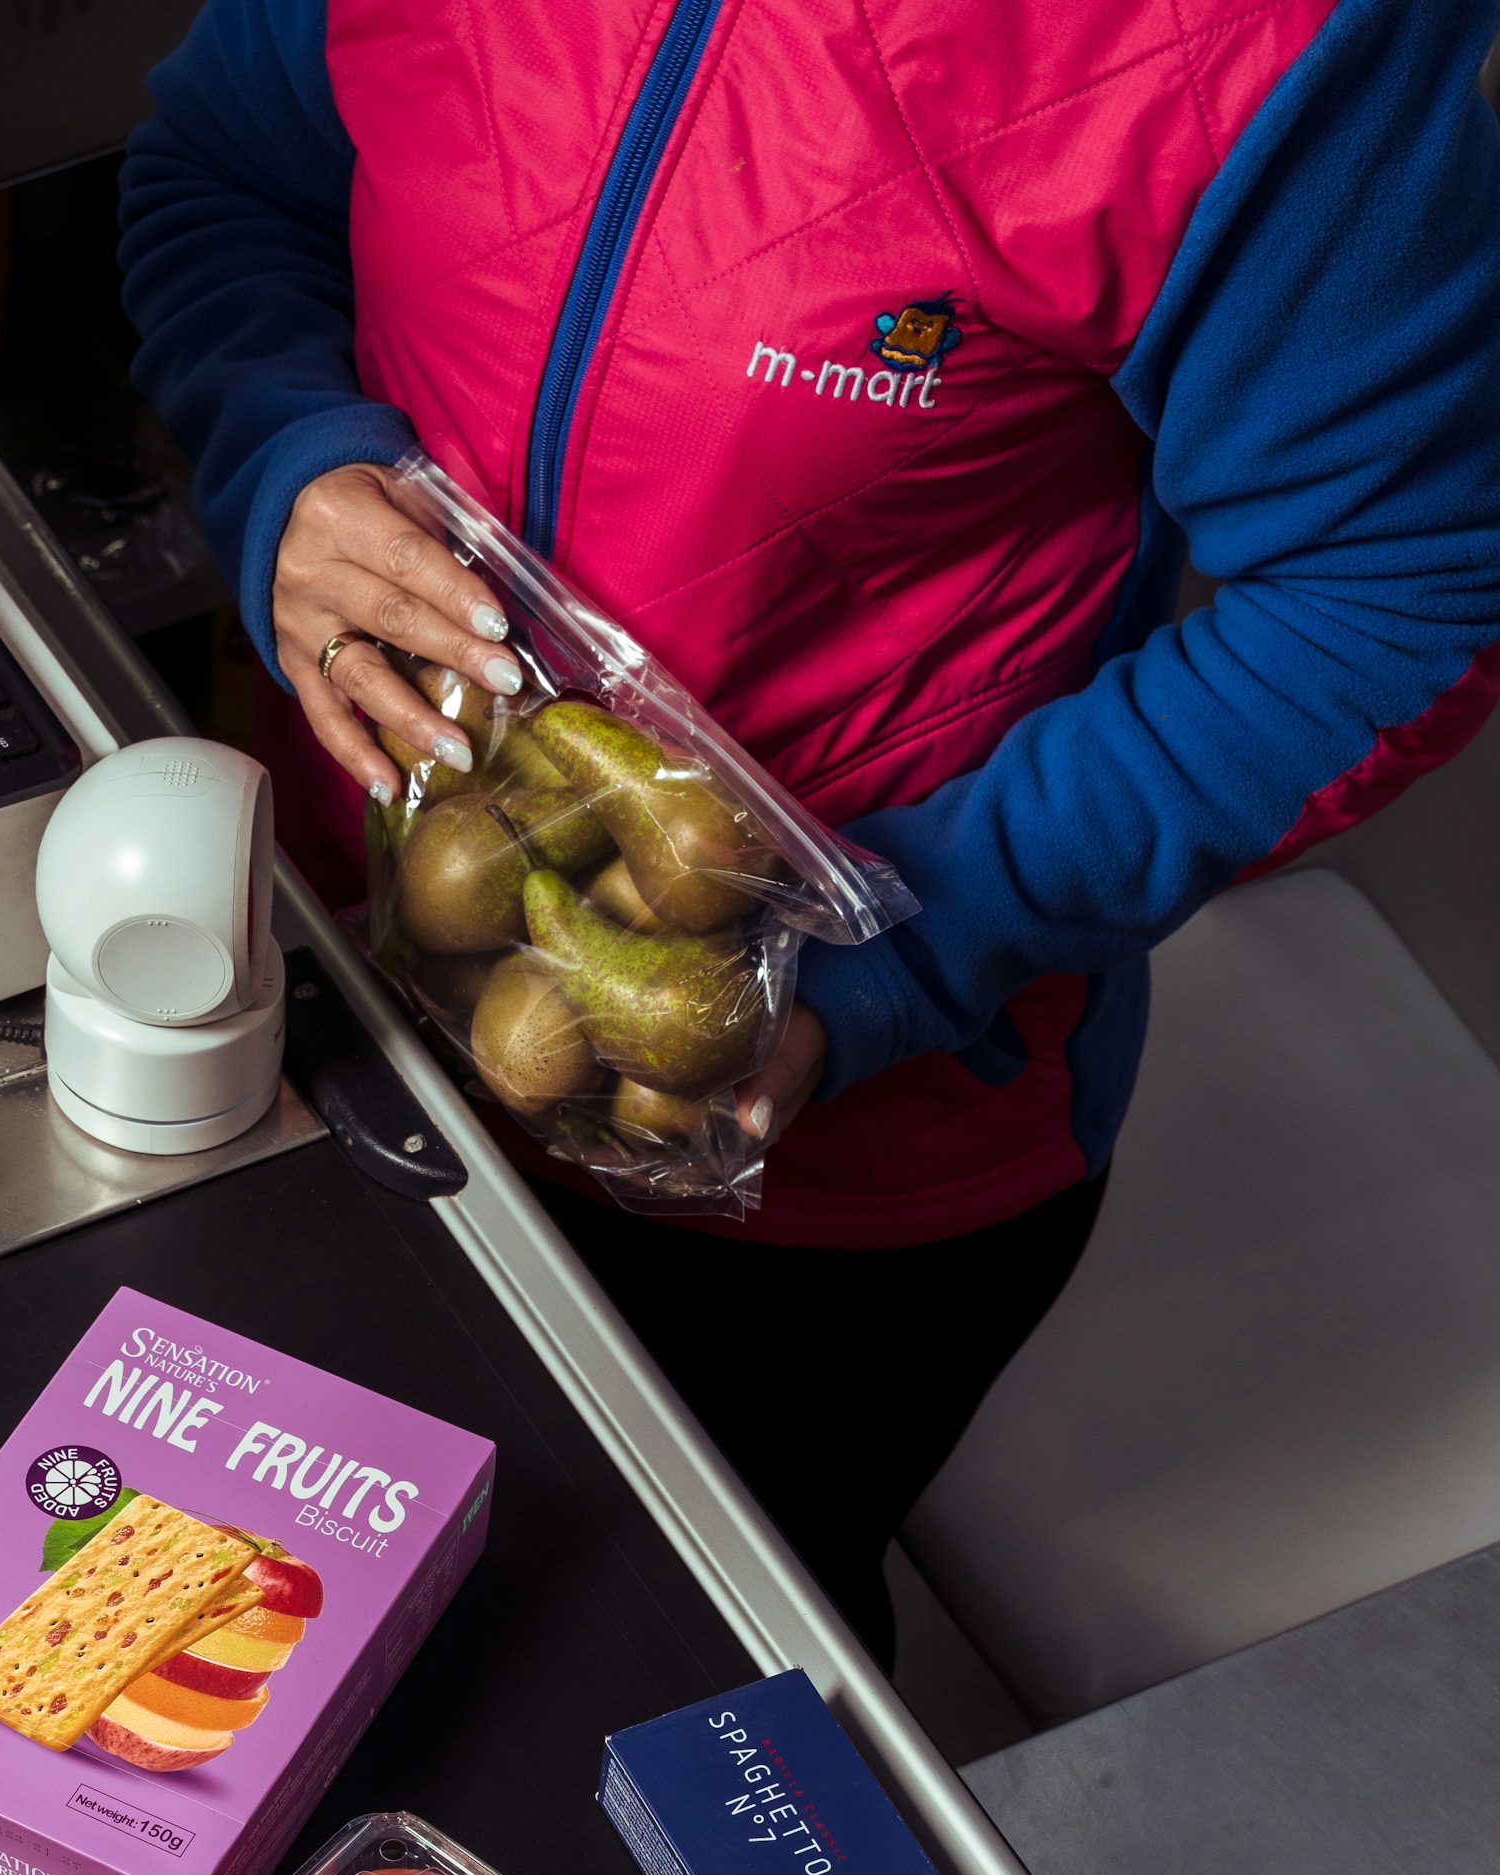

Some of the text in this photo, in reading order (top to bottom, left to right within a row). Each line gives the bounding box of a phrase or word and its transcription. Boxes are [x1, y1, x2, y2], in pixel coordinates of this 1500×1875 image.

[121, 1327, 262, 1395] SENSATION
[145, 1354, 218, 1394] NATURE'S
[83, 1359, 224, 1453] NINE
[225, 1421, 419, 1533] FRUITS
[30, 1448, 118, 1518] NINE FRUITS ADDED
[294, 1503, 389, 1559] Biscuit
[75, 1793, 185, 1851] Net weight: 150g
